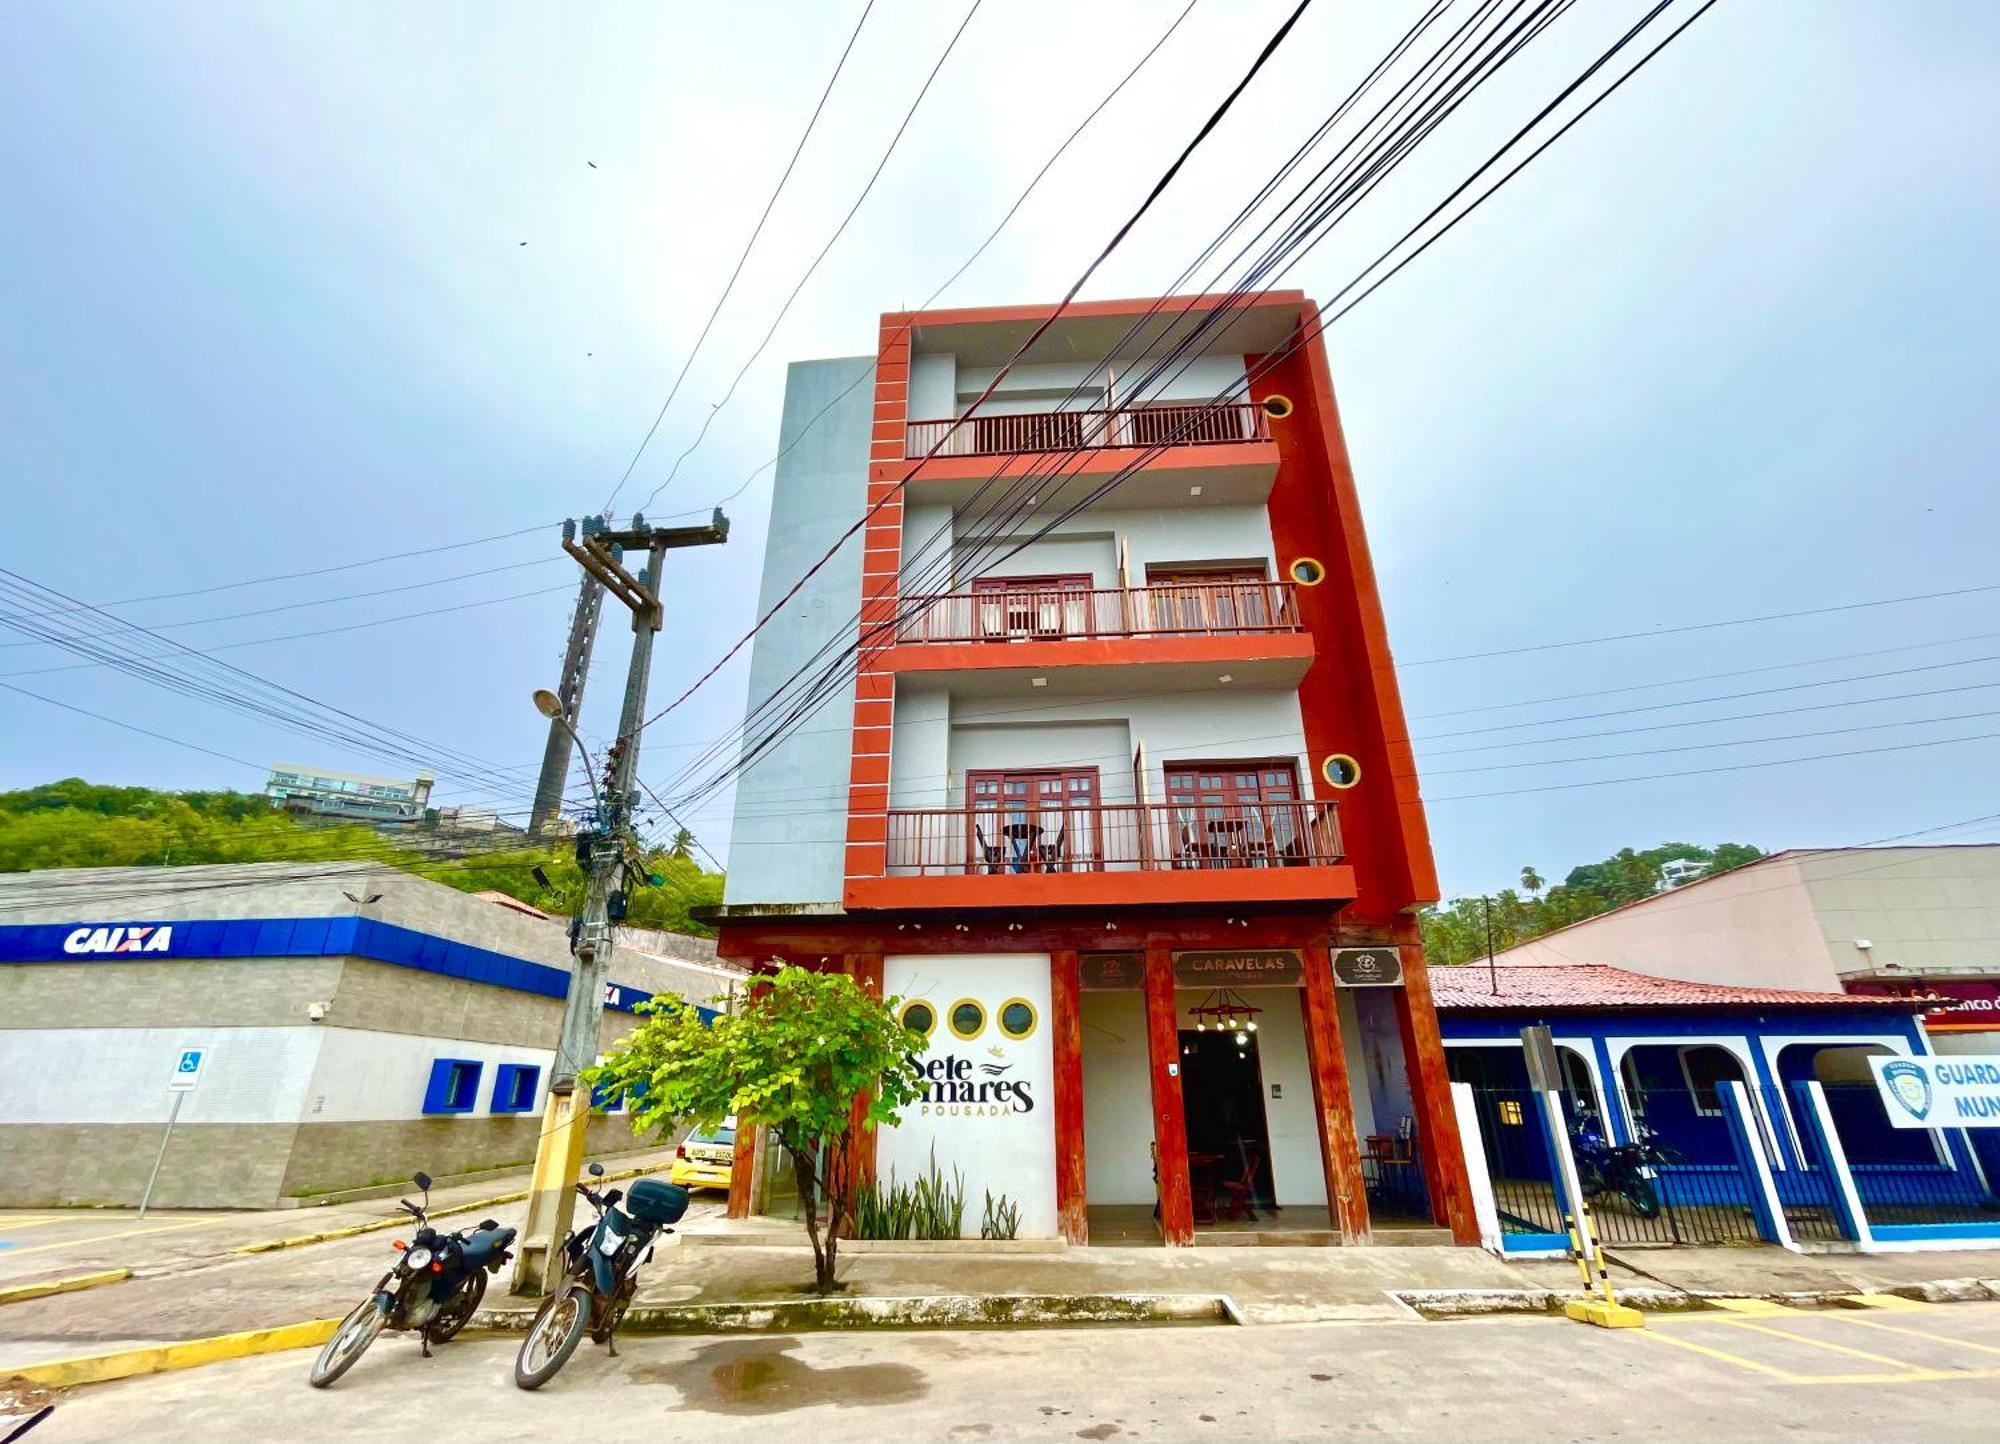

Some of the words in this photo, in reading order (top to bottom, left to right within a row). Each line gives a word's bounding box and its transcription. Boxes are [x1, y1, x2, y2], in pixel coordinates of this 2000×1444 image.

[64, 926, 173, 954] CAIXA
[1192, 957, 1286, 971] CARAVELAS
[905, 1050, 973, 1081] Sete
[1935, 1064, 2000, 1085] GUARD
[920, 1080, 1034, 1113] mares
[921, 1105, 1013, 1117] POUSADA
